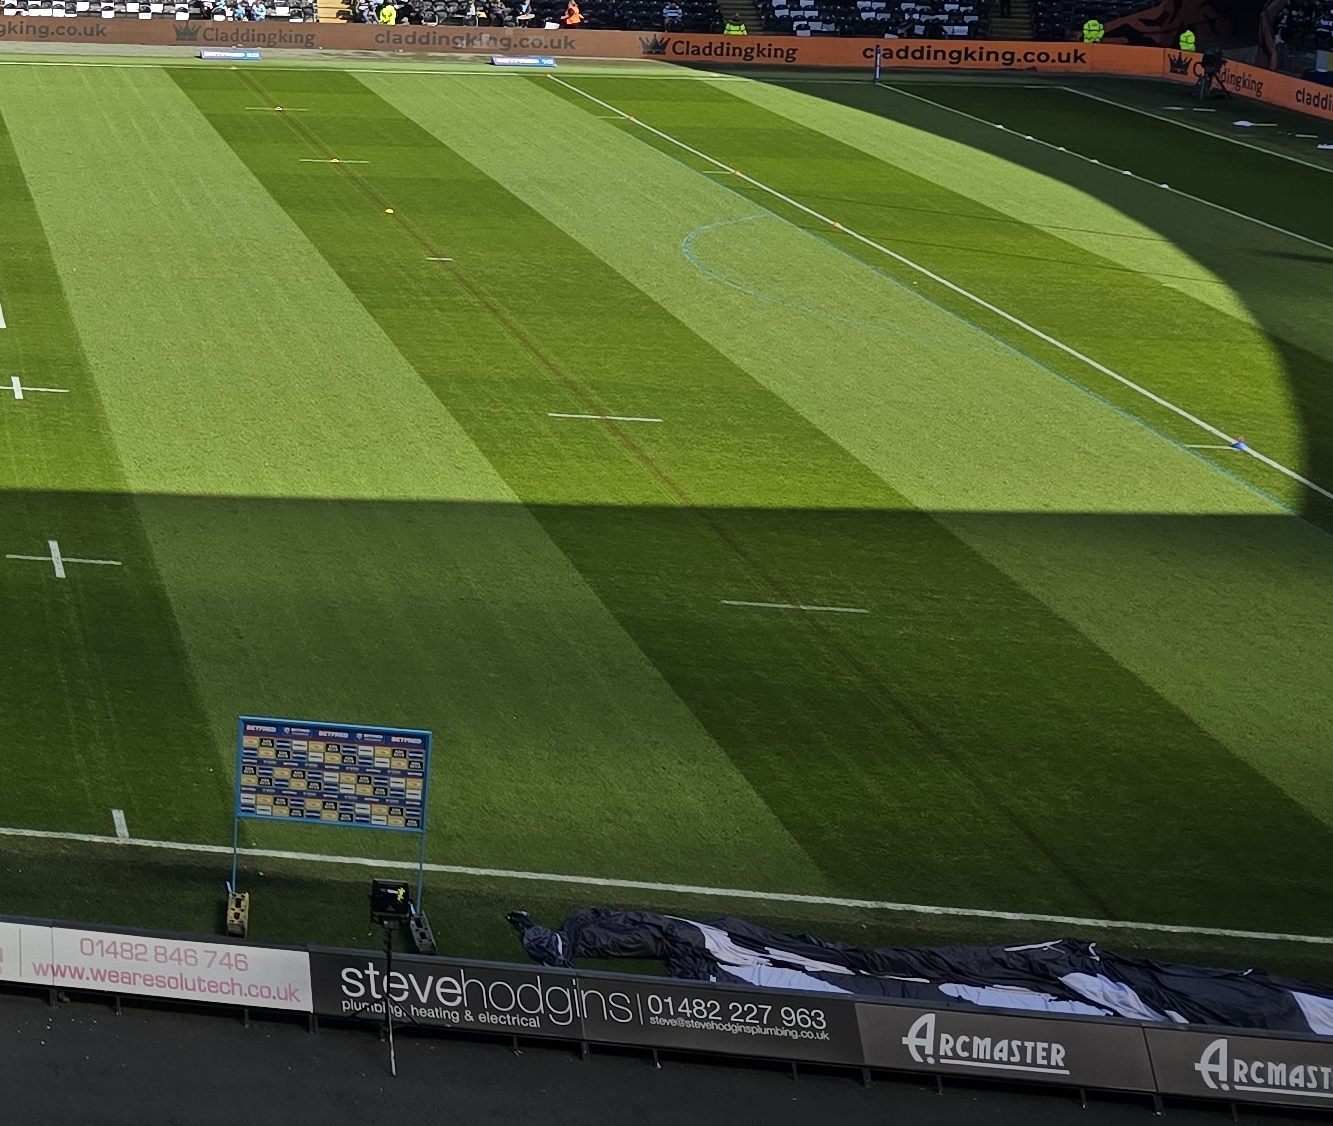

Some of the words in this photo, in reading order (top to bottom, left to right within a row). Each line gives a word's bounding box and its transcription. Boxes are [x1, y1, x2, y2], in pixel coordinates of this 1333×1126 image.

[203, 26, 316, 48] Claddingking
[375, 30, 576, 52] claddingking.co.uk
[672, 40, 798, 63] Claddingking
[862, 44, 1086, 67] caddingking.co.uk
[1296, 88, 1333, 112] claddi
[80, 938, 149, 963] 01482
[154, 945, 198, 967] 846
[203, 950, 249, 972] 746
[32, 961, 301, 1003] www.wearesolutech.co.uk
[341, 962, 634, 1026] stevehodgins
[411, 1005, 460, 1023] heating
[464, 1009, 475, 1022] &
[478, 1012, 540, 1028] electrical
[647, 994, 722, 1021] 01482
[728, 1002, 772, 1025] 227
[780, 1006, 827, 1030] 963
[650, 1016, 829, 1041] steve@stevehodginsplumbing.co.uk
[902, 1013, 1066, 1067] ARCMASTER
